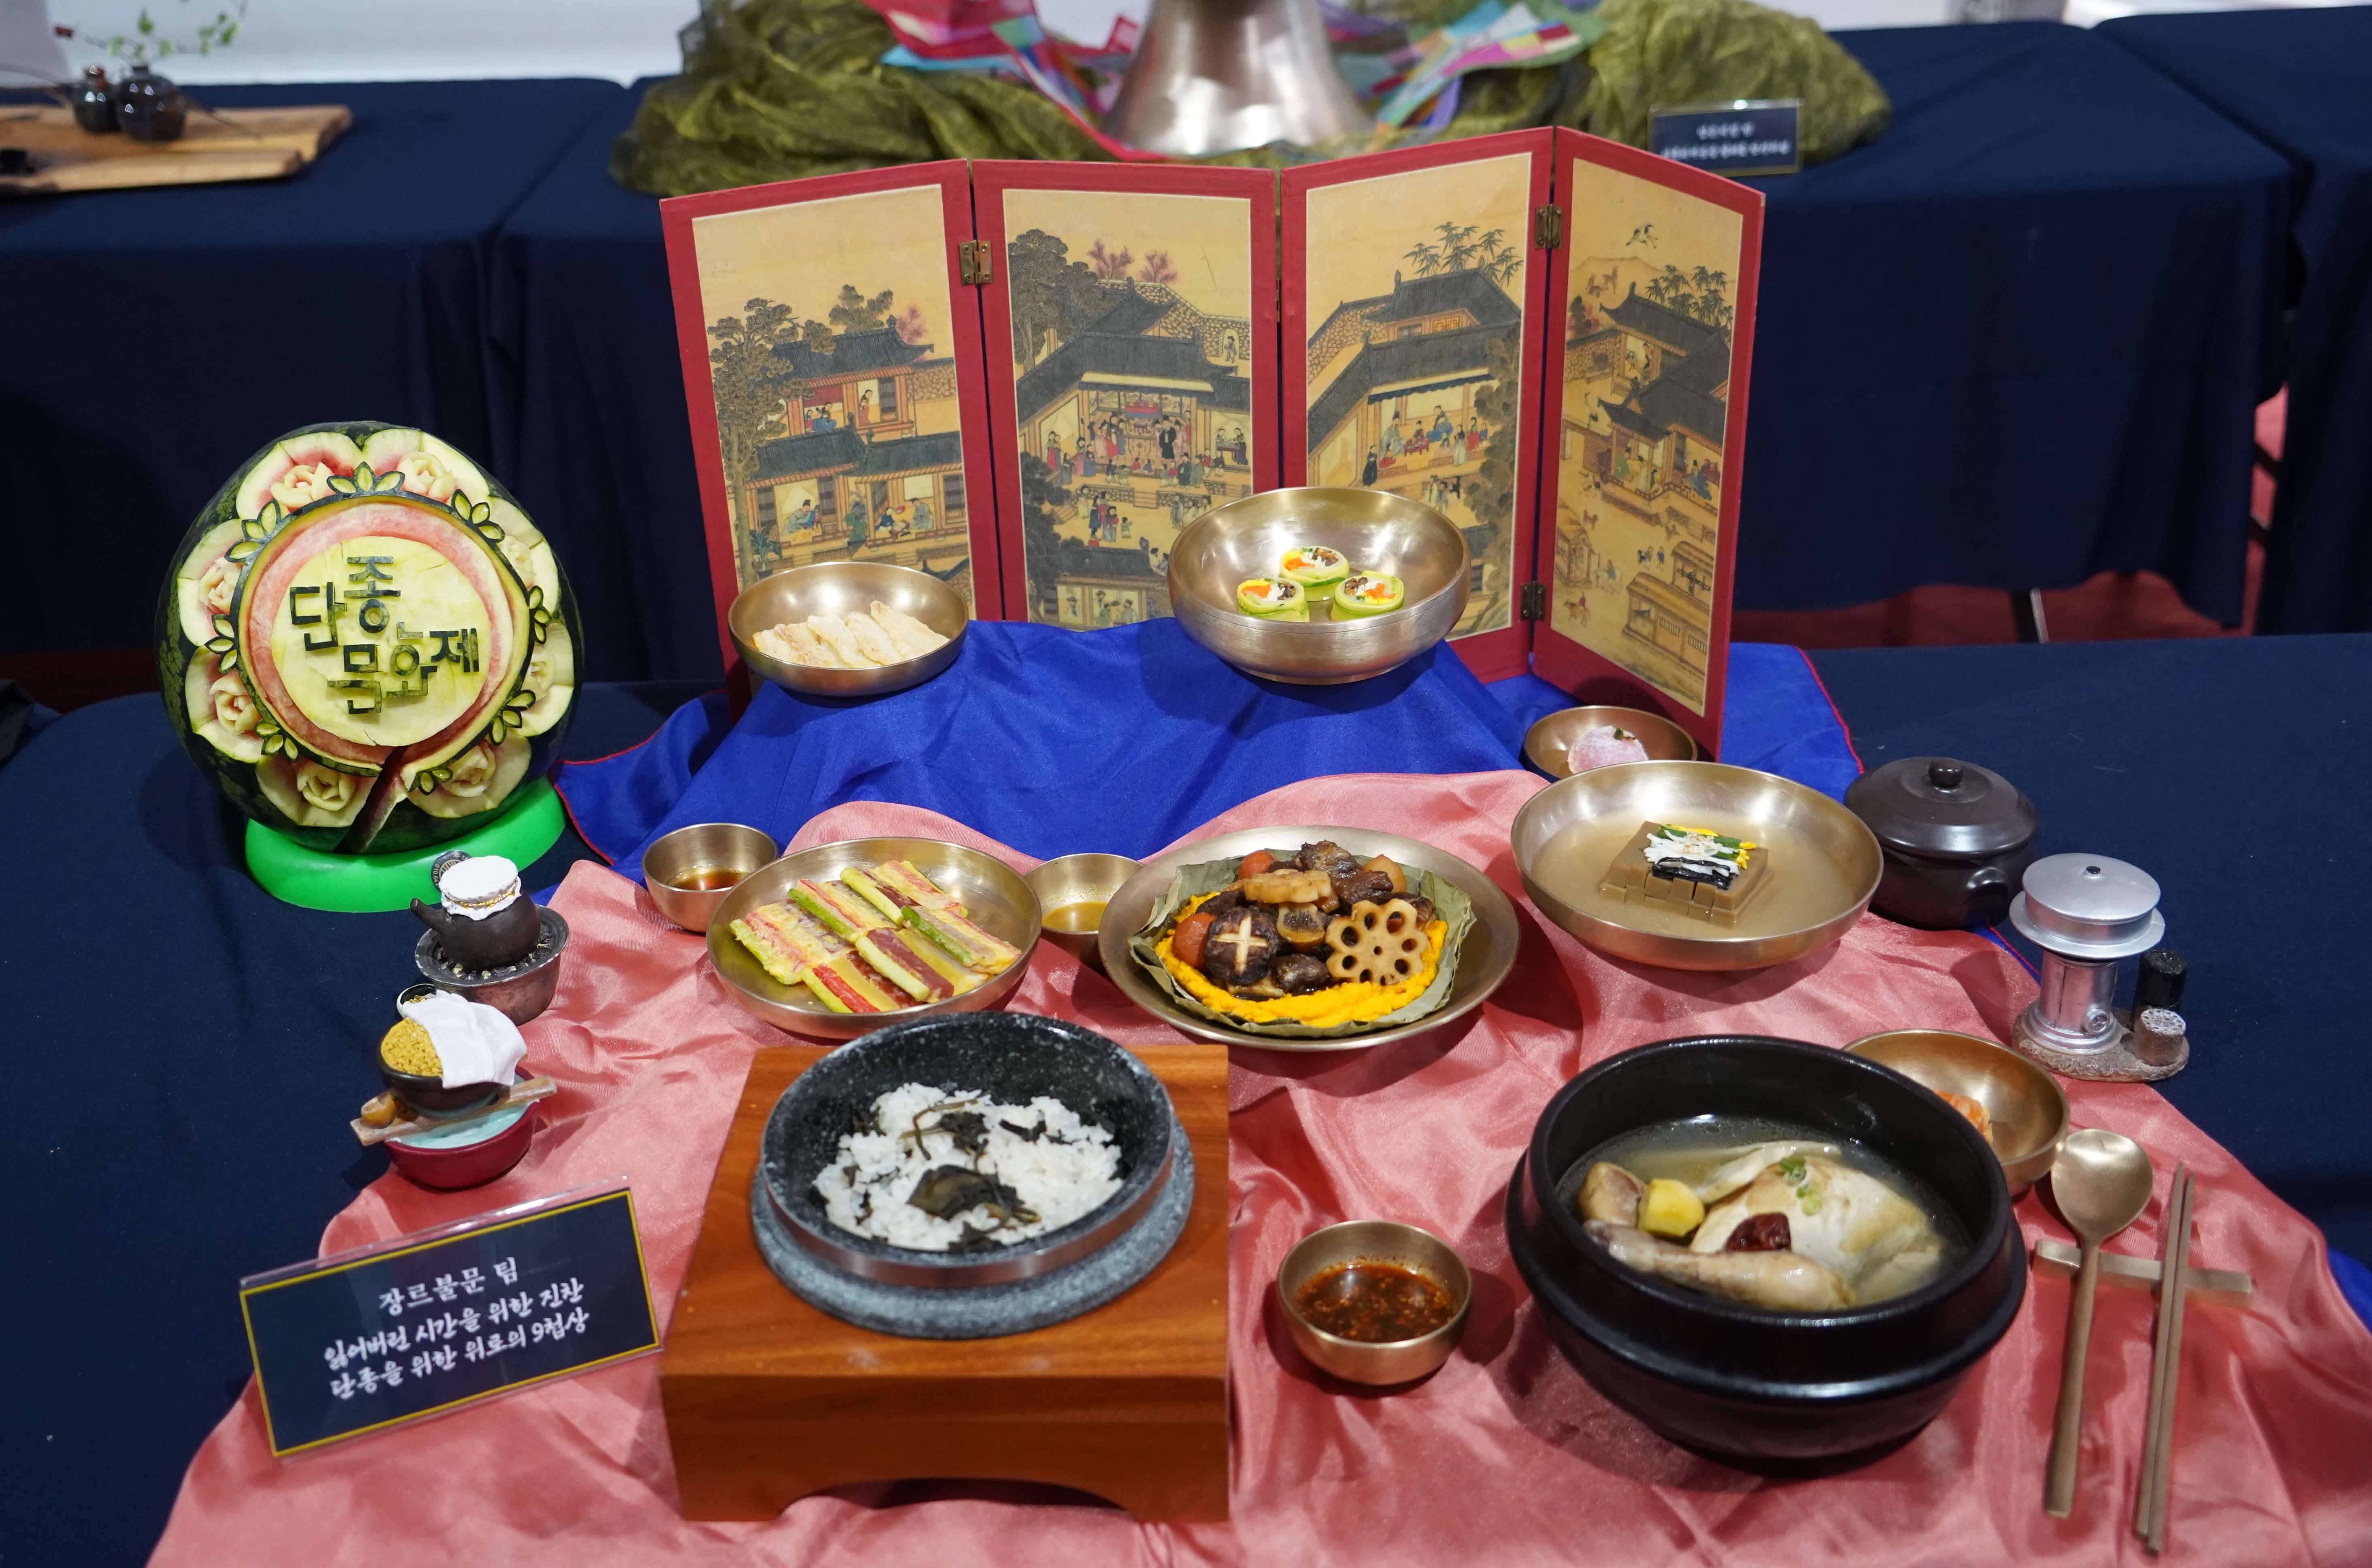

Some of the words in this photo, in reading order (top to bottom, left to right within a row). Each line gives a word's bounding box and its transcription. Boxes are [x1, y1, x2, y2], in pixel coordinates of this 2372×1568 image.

[324, 1325, 411, 1371] 잃어버린
[415, 1307, 481, 1342] 시간을
[488, 1291, 534, 1325] 위한
[539, 1277, 585, 1308] 진찬
[379, 1267, 486, 1316] 장르불문
[493, 1256, 518, 1285] 팀
[330, 1360, 404, 1400] 단종을
[411, 1344, 458, 1378] 위한
[464, 1324, 526, 1362] 위로의
[531, 1306, 590, 1343] 9첩상
